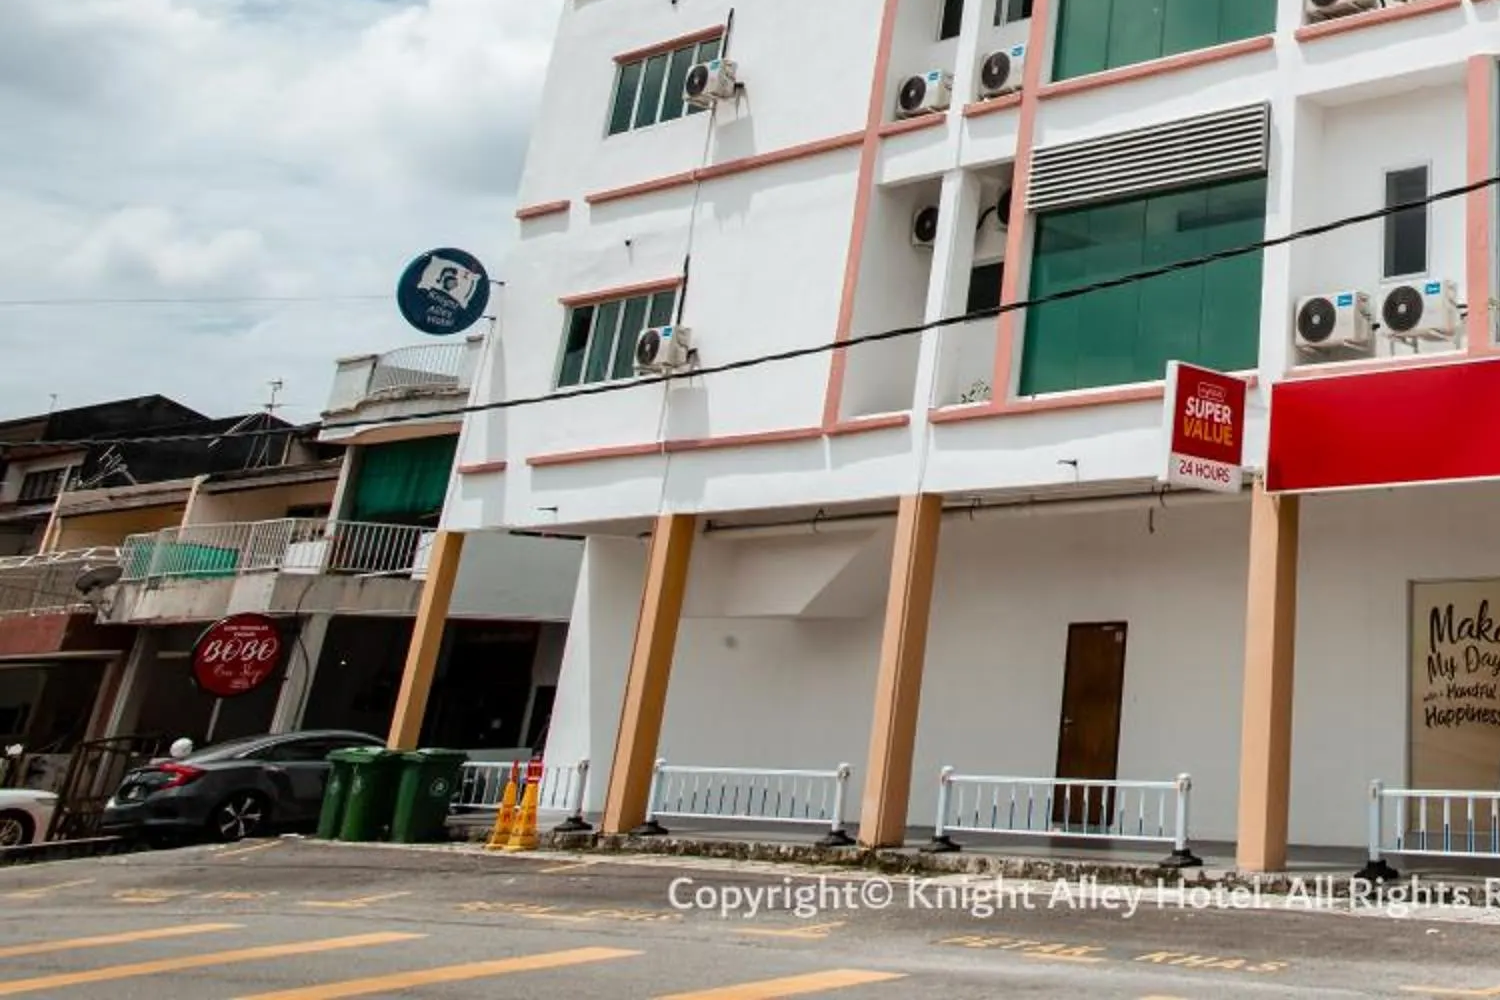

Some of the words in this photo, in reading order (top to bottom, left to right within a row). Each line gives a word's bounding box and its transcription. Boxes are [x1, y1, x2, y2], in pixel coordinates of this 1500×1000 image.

[1185, 397, 1232, 424] SUPER
[1183, 416, 1233, 446] VALUE
[1179, 459, 1193, 476] 24
[1195, 462, 1231, 483] HOURS
[1428, 651, 1456, 684] My
